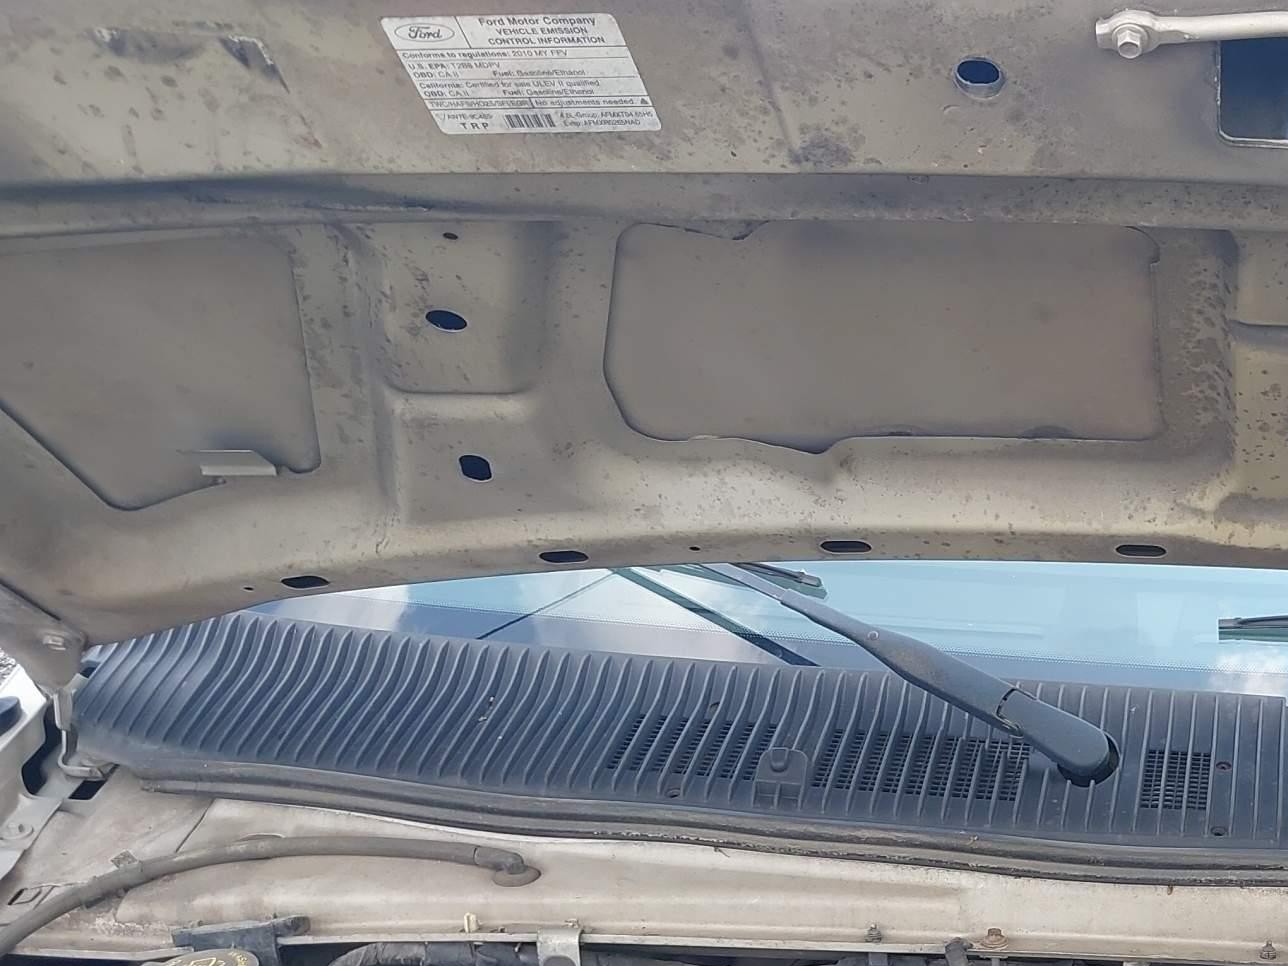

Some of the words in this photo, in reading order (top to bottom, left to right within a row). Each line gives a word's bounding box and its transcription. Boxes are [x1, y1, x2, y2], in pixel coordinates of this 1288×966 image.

[478, 17, 505, 26] Ford
[507, 17, 540, 26] Motor
[542, 15, 596, 26] Company
[408, 25, 442, 39] Ford
[495, 27, 539, 35] VEHICLE
[540, 26, 588, 35] EMISSION
[488, 37, 536, 46] CONTROL
[537, 35, 606, 44] INFORMATION
[402, 51, 446, 59] Conforms
[458, 50, 510, 60] regulations:
[512, 49, 533, 57] 2010
[534, 49, 549, 57] MY
[492, 69, 515, 77] Fuel:
[419, 81, 464, 89] California:
[465, 80, 500, 88] Certified
[500, 80, 513, 88] for
[565, 79, 600, 89] qualified
[502, 88, 524, 96] Fuel:
[460, 122, 468, 130] T
[470, 122, 481, 130] R
